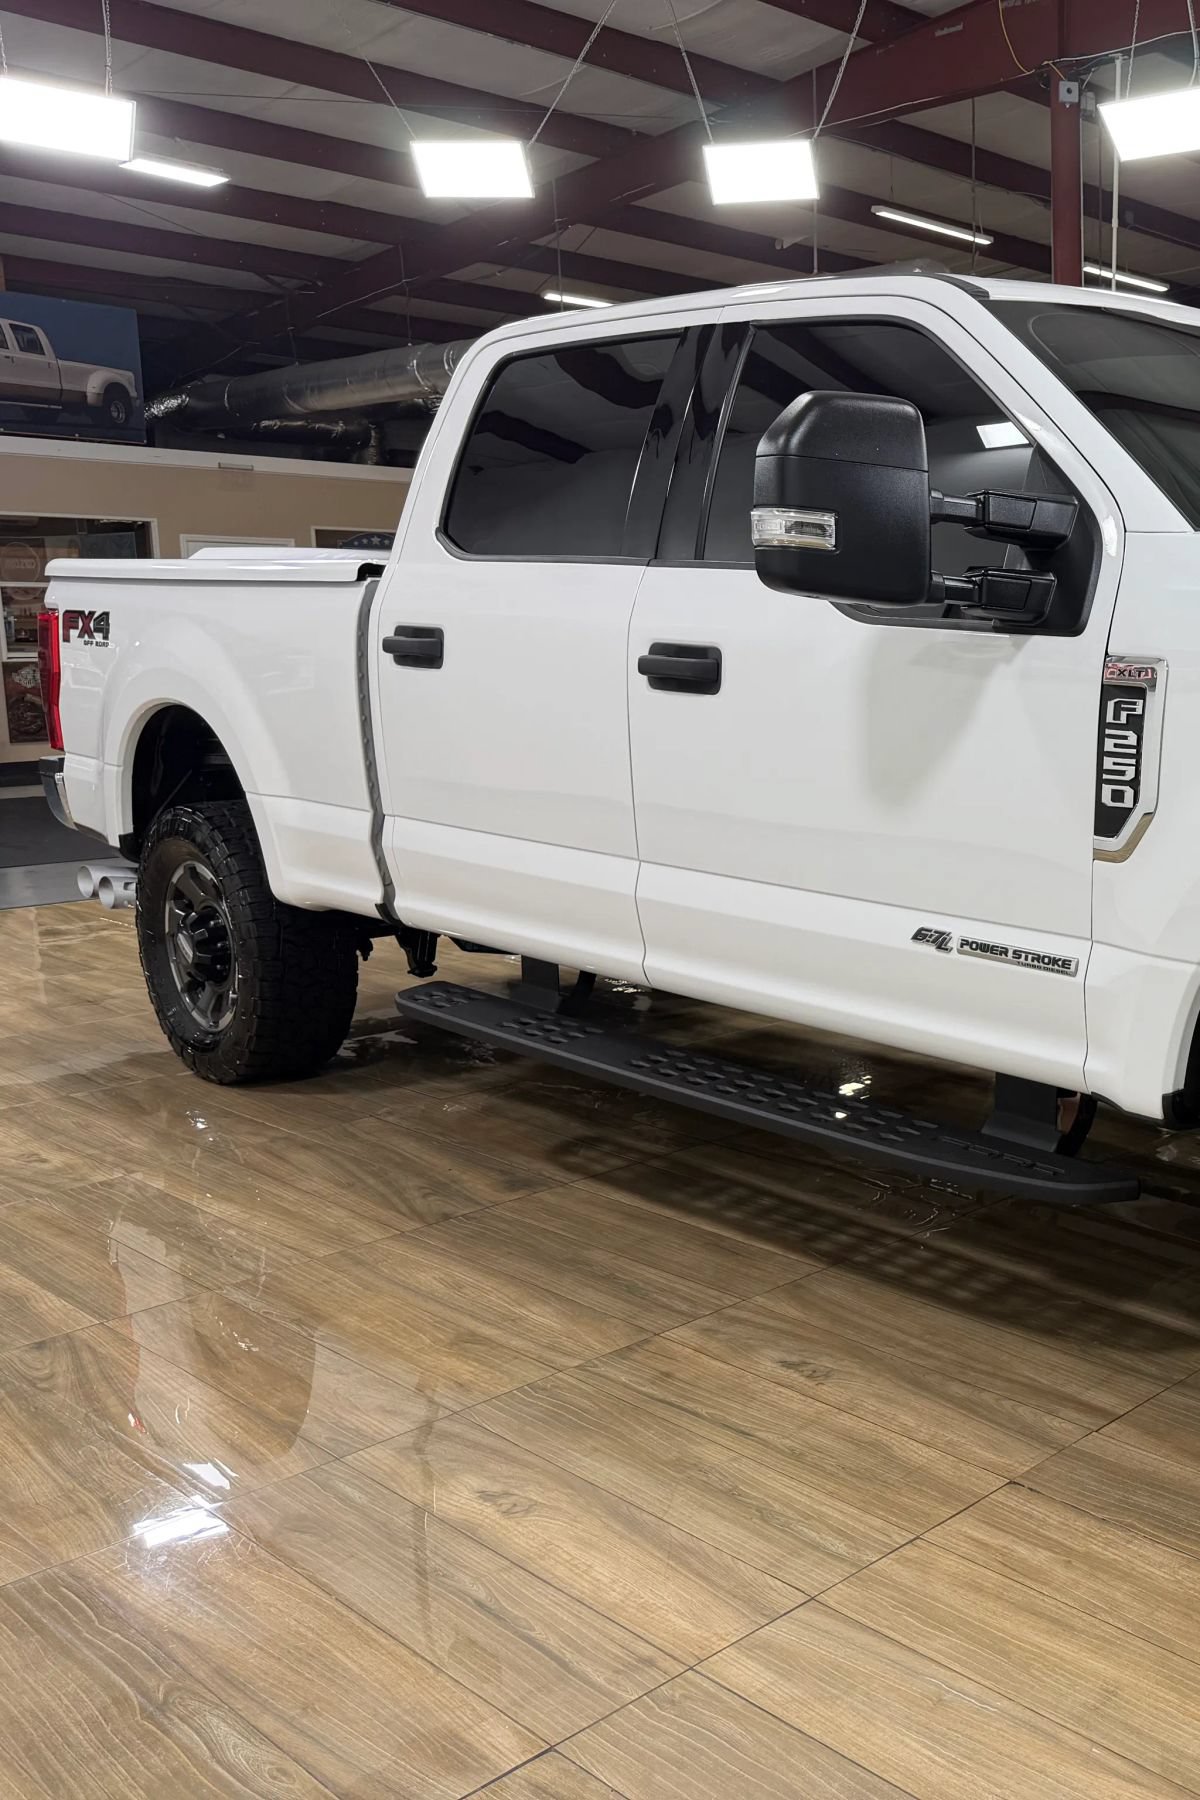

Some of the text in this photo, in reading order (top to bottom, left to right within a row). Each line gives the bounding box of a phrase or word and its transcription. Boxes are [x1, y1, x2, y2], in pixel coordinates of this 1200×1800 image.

[62, 609, 110, 643] FX4
[1117, 668, 1146, 678] XLT
[1102, 698, 1143, 808] F250
[960, 939, 1073, 971] POWER STROKE
[1016, 960, 1042, 971] TURBO
